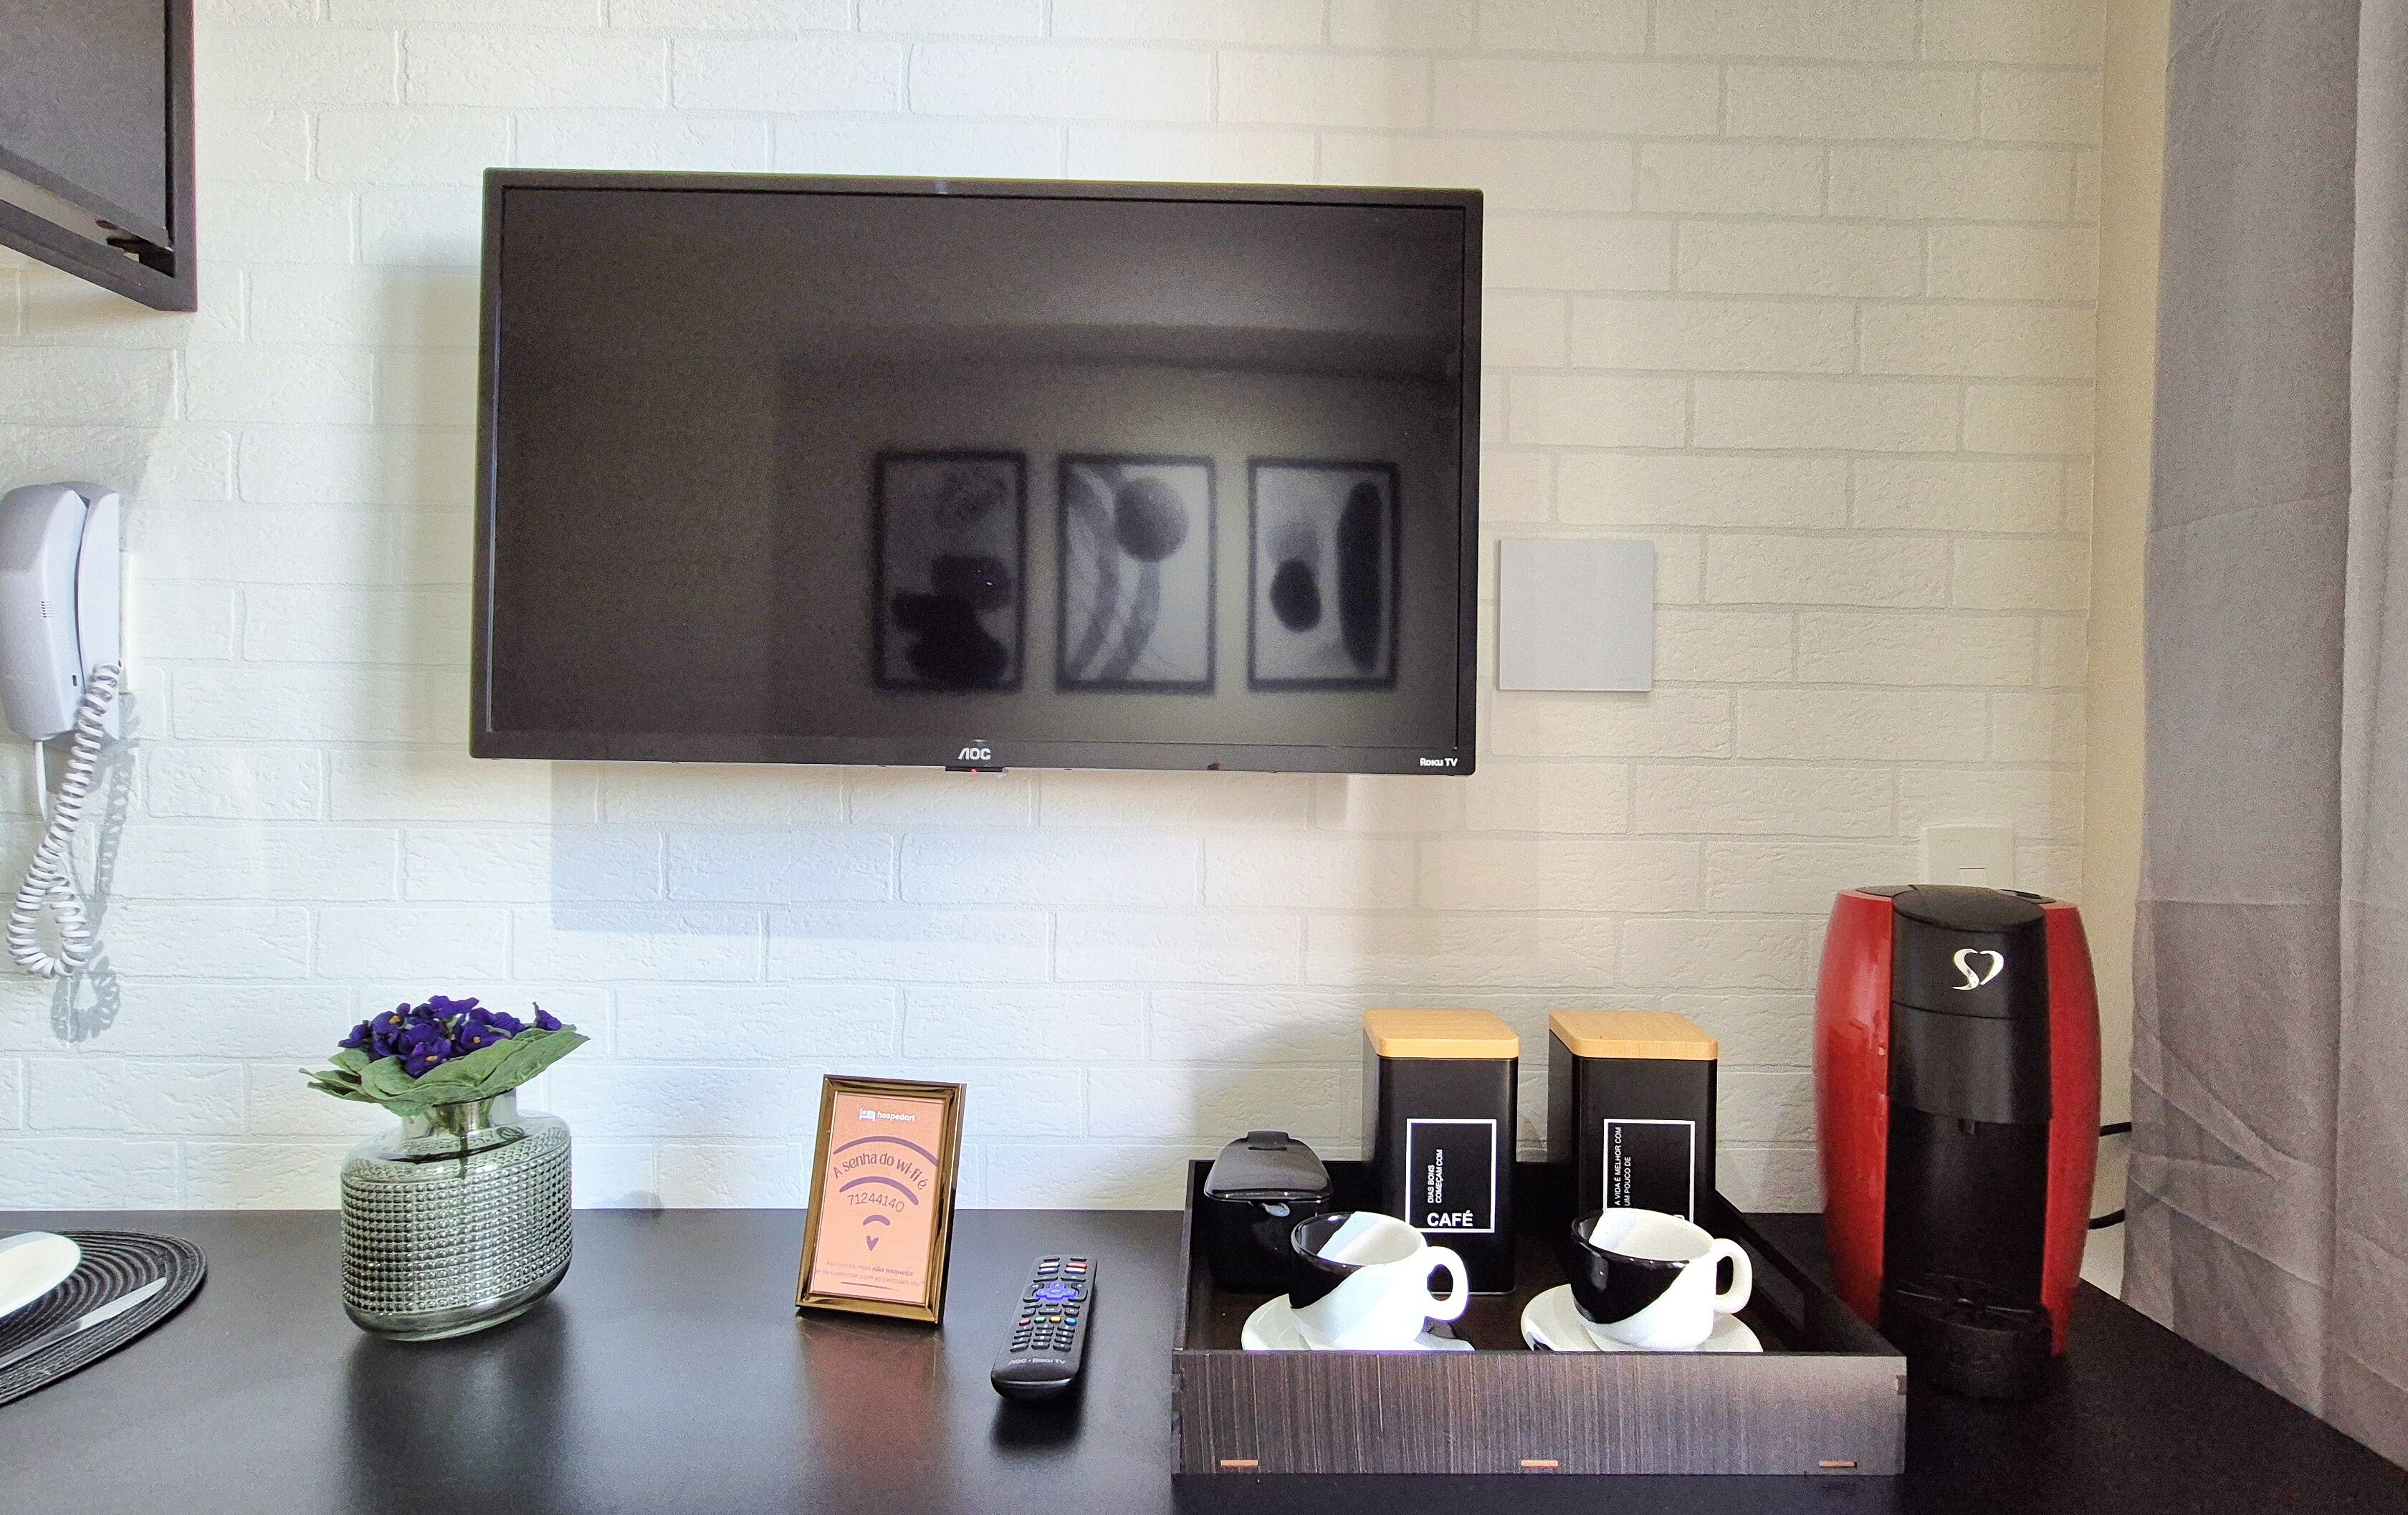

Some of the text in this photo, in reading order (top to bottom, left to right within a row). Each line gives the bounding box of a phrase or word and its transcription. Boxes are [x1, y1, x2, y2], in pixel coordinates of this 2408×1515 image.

[957, 747, 991, 760] AOC
[877, 1112, 916, 1122] hospedart
[1625, 1157, 1630, 1166] DE
[833, 1153, 928, 1190] A senha do wi-fi é
[848, 1193, 904, 1212] 71244140
[1624, 1195, 1630, 1206] UM
[1427, 1210, 1473, 1226] CAFÉ
